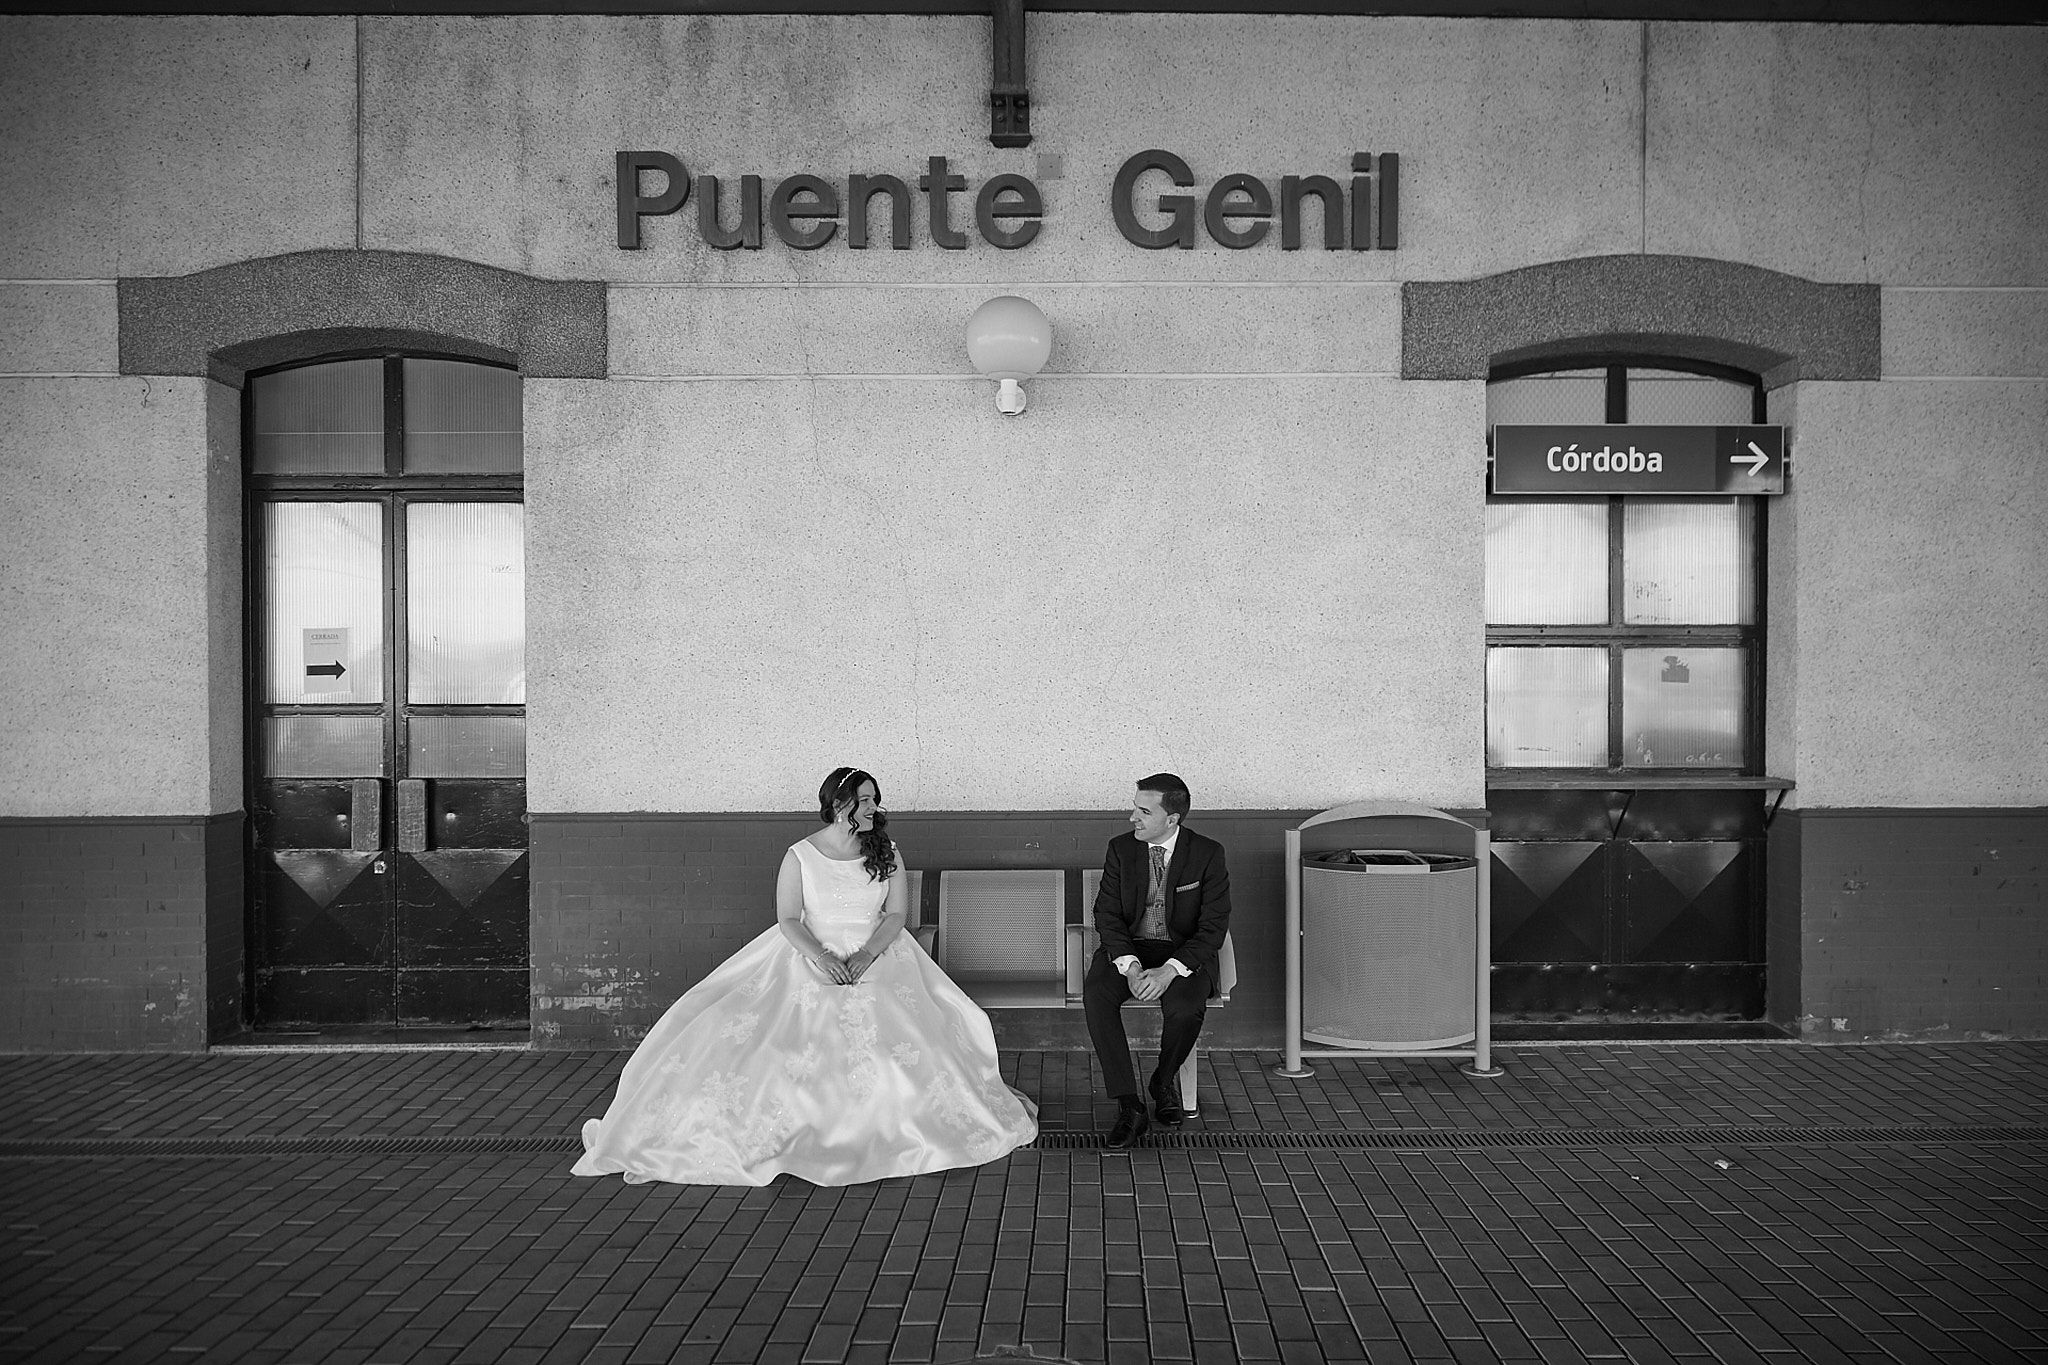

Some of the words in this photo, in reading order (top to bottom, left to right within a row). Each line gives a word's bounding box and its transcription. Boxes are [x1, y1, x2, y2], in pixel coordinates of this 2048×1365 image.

[615, 150, 1043, 252] Puente
[1110, 148, 1400, 252] Genil
[1546, 443, 1664, 474] Córdoba
